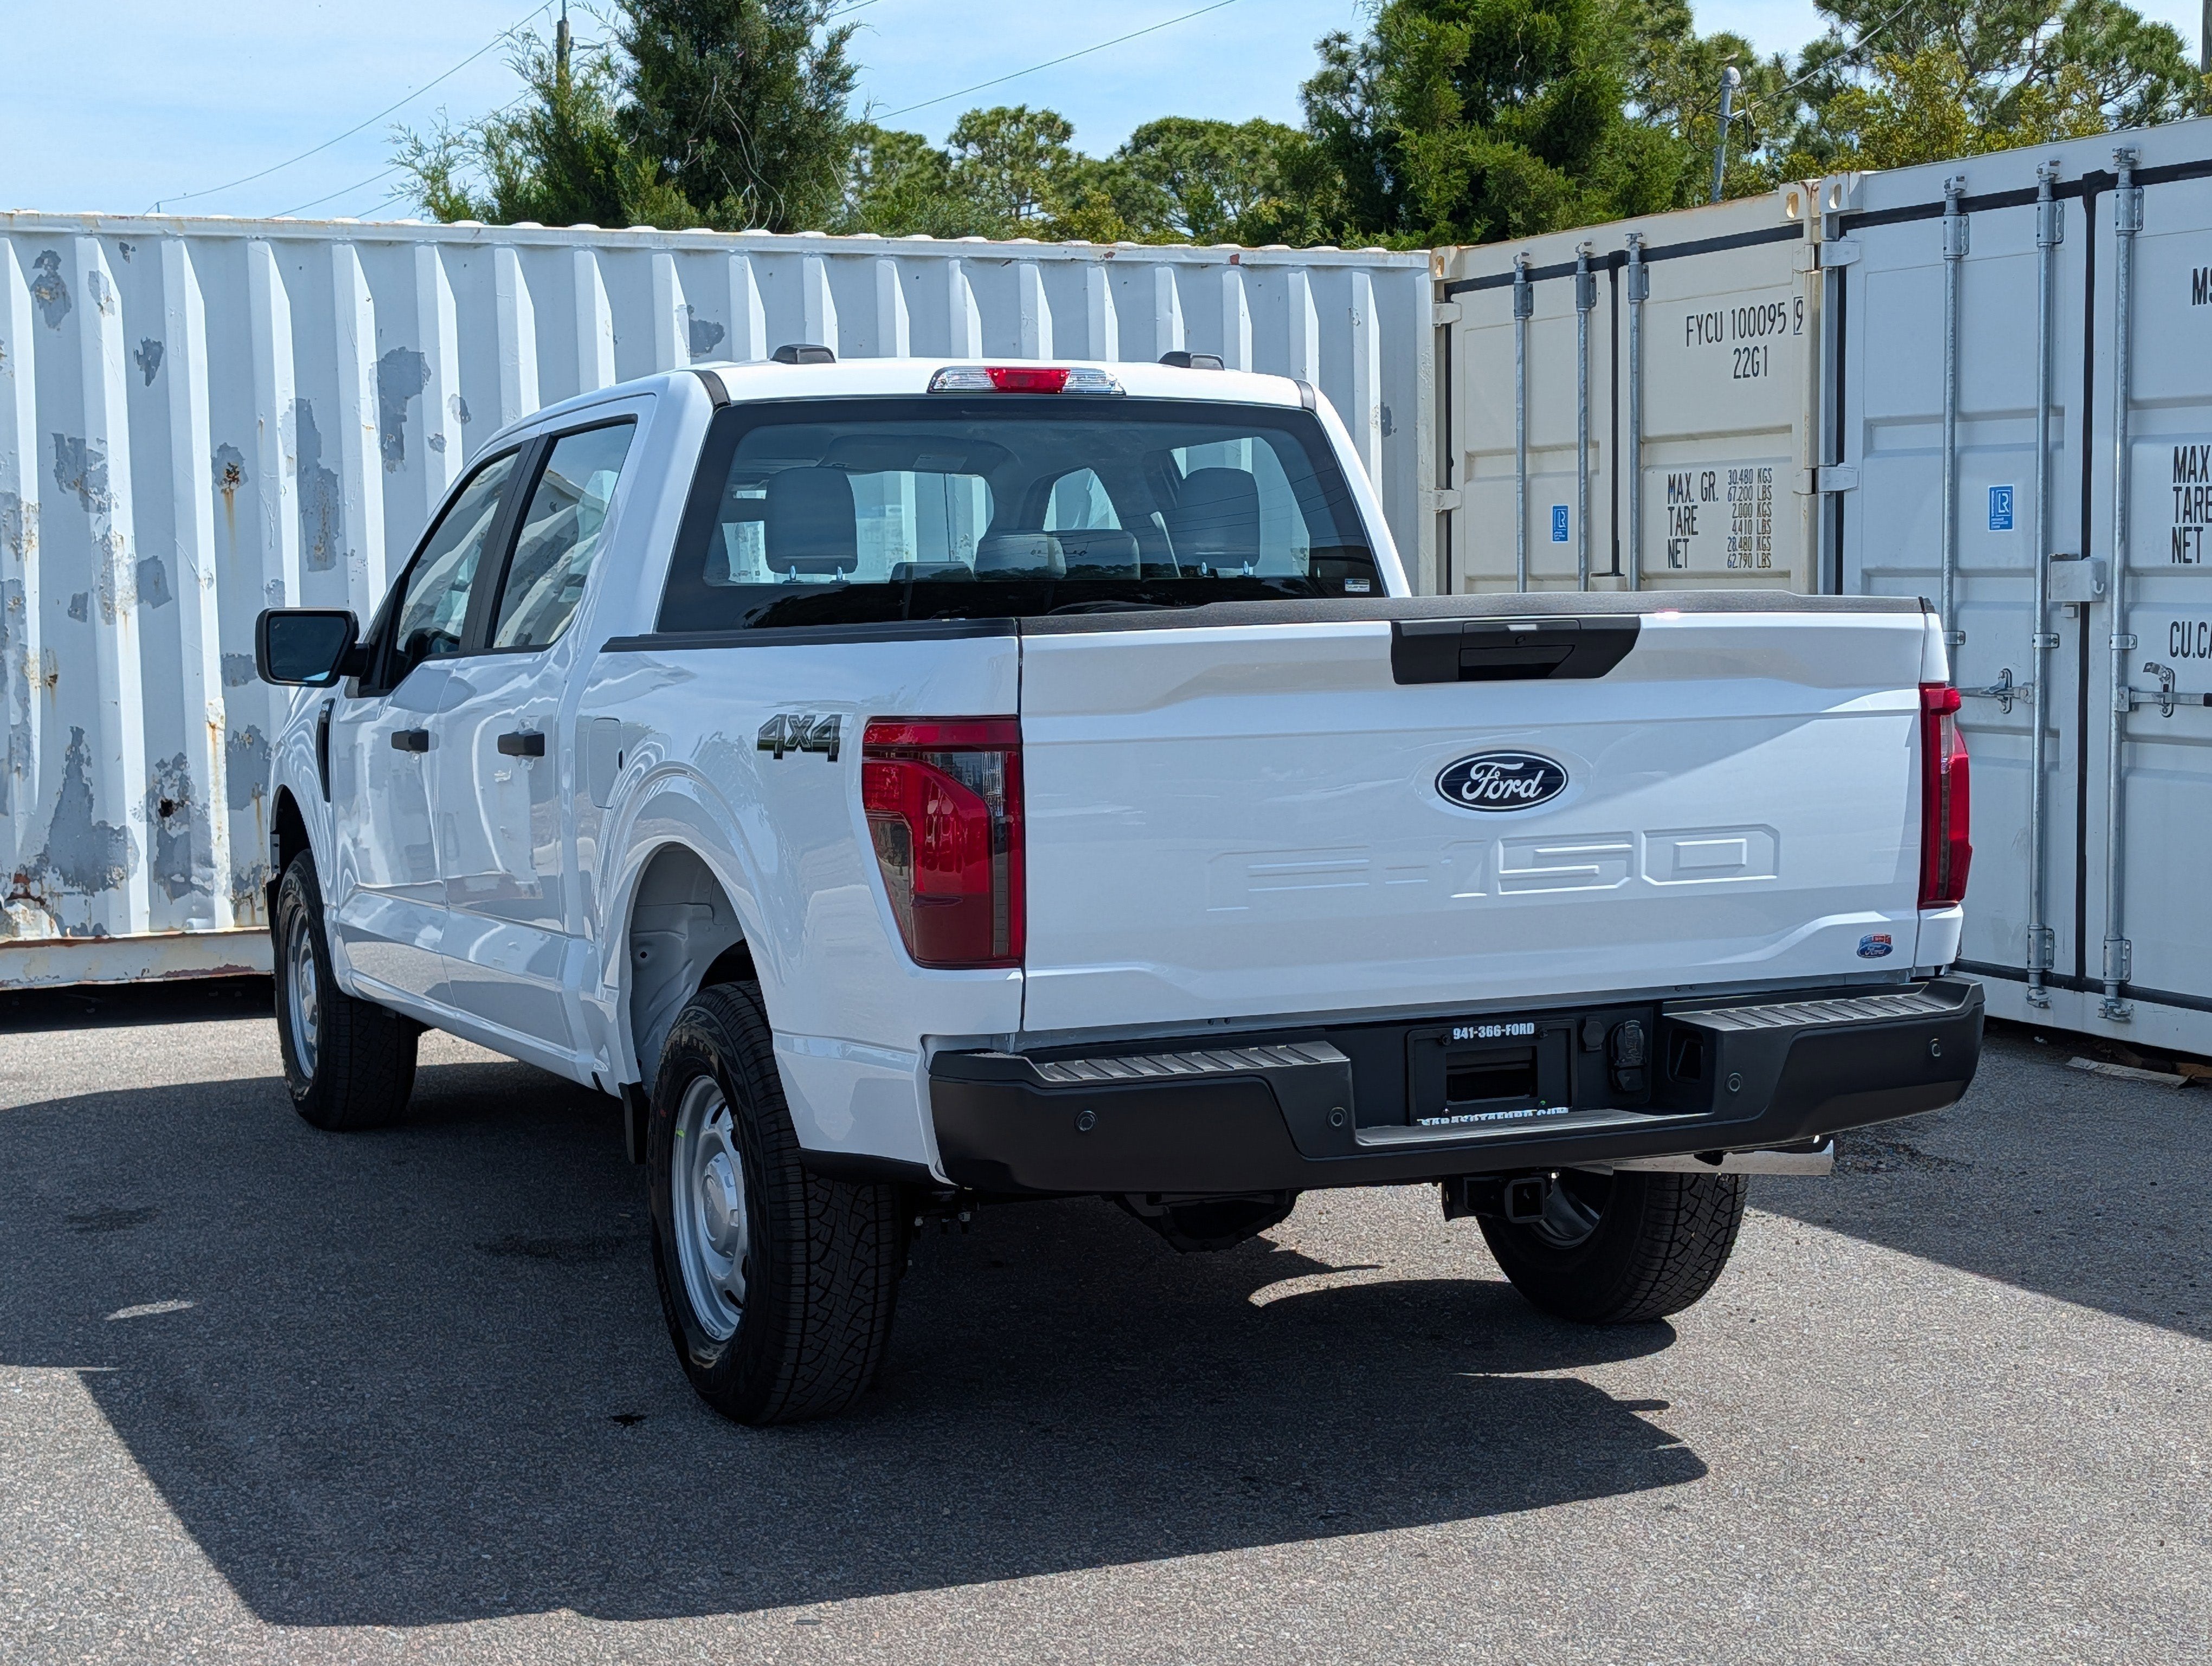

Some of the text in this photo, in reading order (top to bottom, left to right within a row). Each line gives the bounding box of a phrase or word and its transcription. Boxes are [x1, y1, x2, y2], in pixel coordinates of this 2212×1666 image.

[1686, 311, 1723, 347] FYCU
[1731, 302, 1787, 341] 100095
[1733, 344, 1767, 379] 22G1
[2172, 444, 2212, 484] MAX
[1667, 472, 1694, 504] MAX.
[1700, 471, 1719, 502] GR.
[1757, 467, 1772, 484] KGS
[1757, 484, 1772, 502] LBS
[1667, 505, 1699, 537] TARE
[1757, 501, 1772, 518] KGS
[2172, 486, 2212, 524] TARE
[1756, 518, 1772, 535] LBS
[1667, 538, 1689, 569] NET
[1756, 536, 1772, 552] KGS
[1756, 552, 1772, 569] LBS
[2171, 526, 2204, 564] NET
[1462, 761, 1545, 800] Ford
[1453, 1022, 1535, 1040] 941-366-FORD
